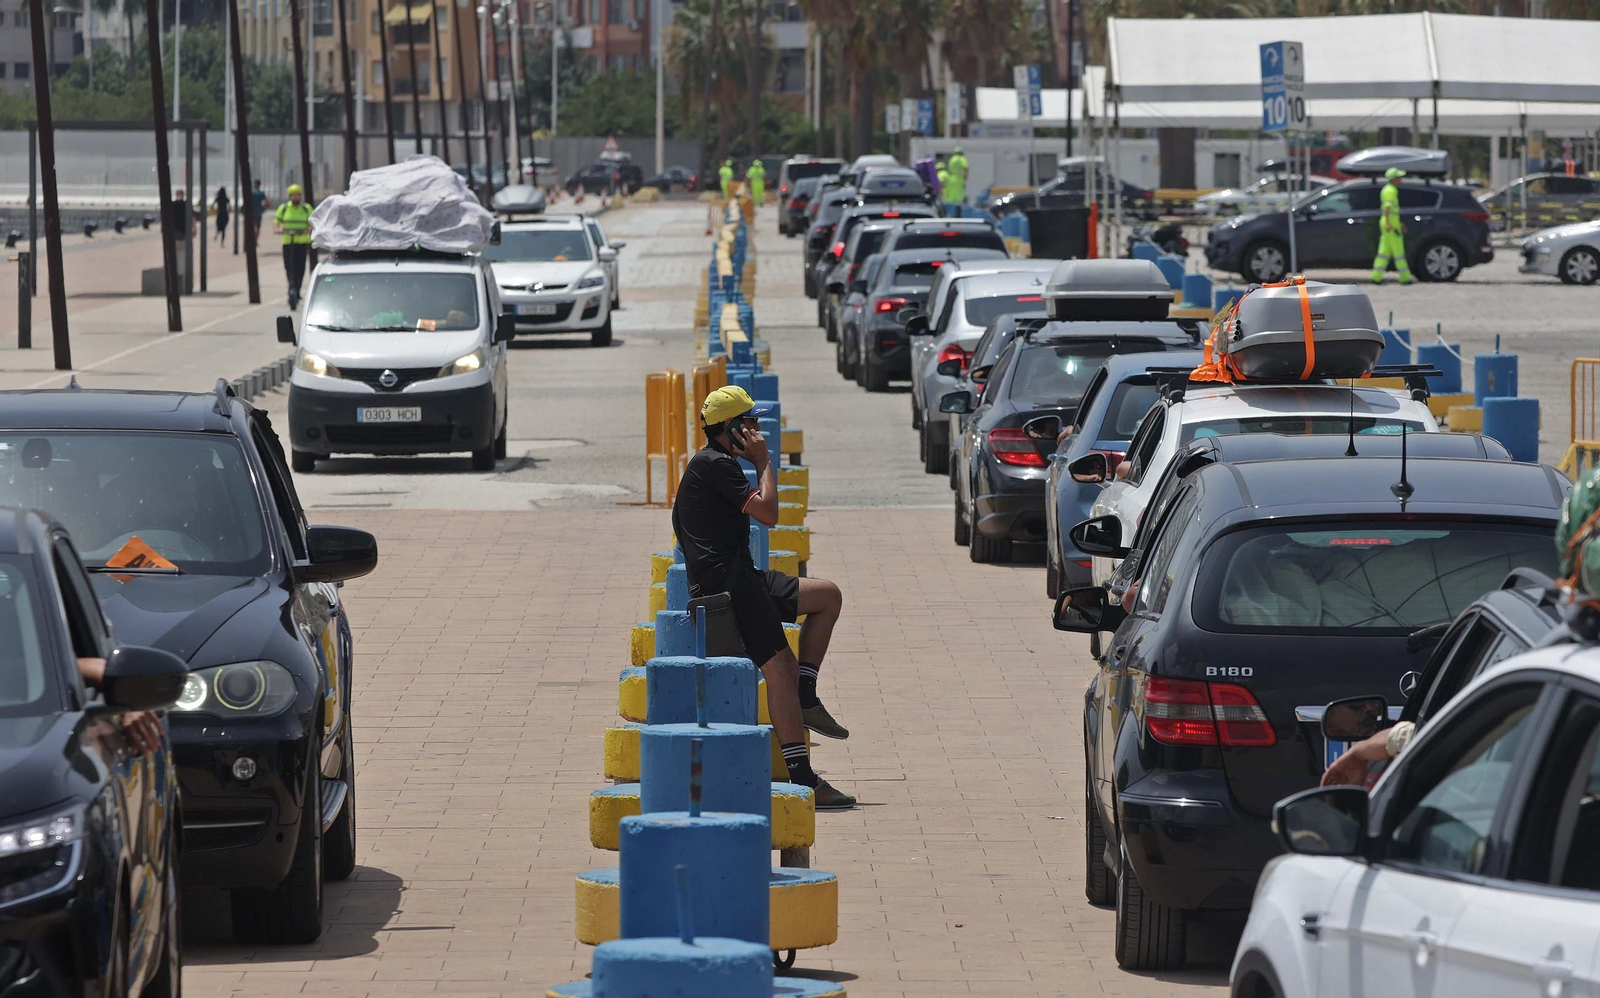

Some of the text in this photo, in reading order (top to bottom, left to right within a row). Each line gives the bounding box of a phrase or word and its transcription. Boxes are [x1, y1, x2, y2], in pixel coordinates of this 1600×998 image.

[1264, 95, 1286, 125] 10
[1288, 96, 1305, 123] 10
[920, 118, 929, 131] 7
[365, 409, 418, 420] 0303 HCH
[1206, 666, 1254, 677] B180
